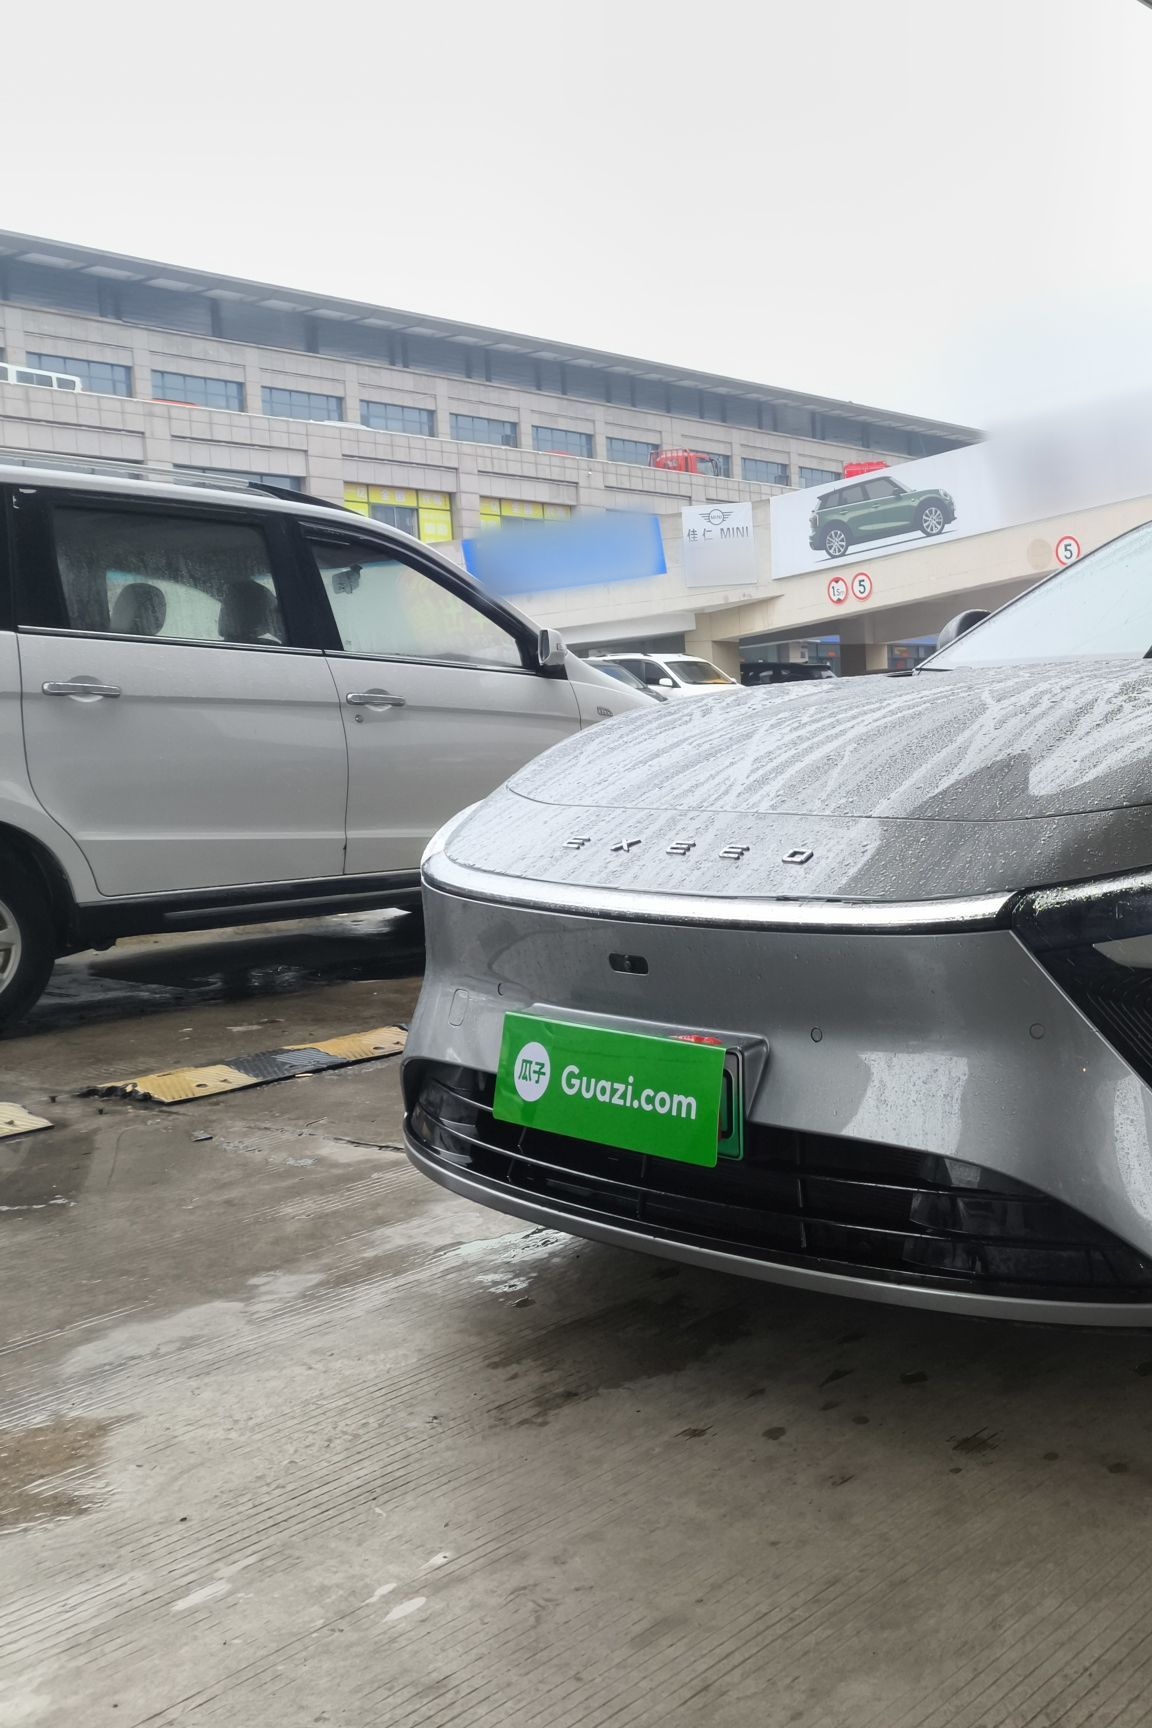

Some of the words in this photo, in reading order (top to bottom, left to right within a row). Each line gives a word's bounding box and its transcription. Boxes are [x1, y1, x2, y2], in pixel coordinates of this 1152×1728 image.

[720, 526, 749, 539] MINI
[1064, 543, 1073, 560] 5
[858, 579, 867, 595] 5
[518, 1058, 547, 1084] 瓜子
[561, 1065, 697, 1120] Guazi.com
